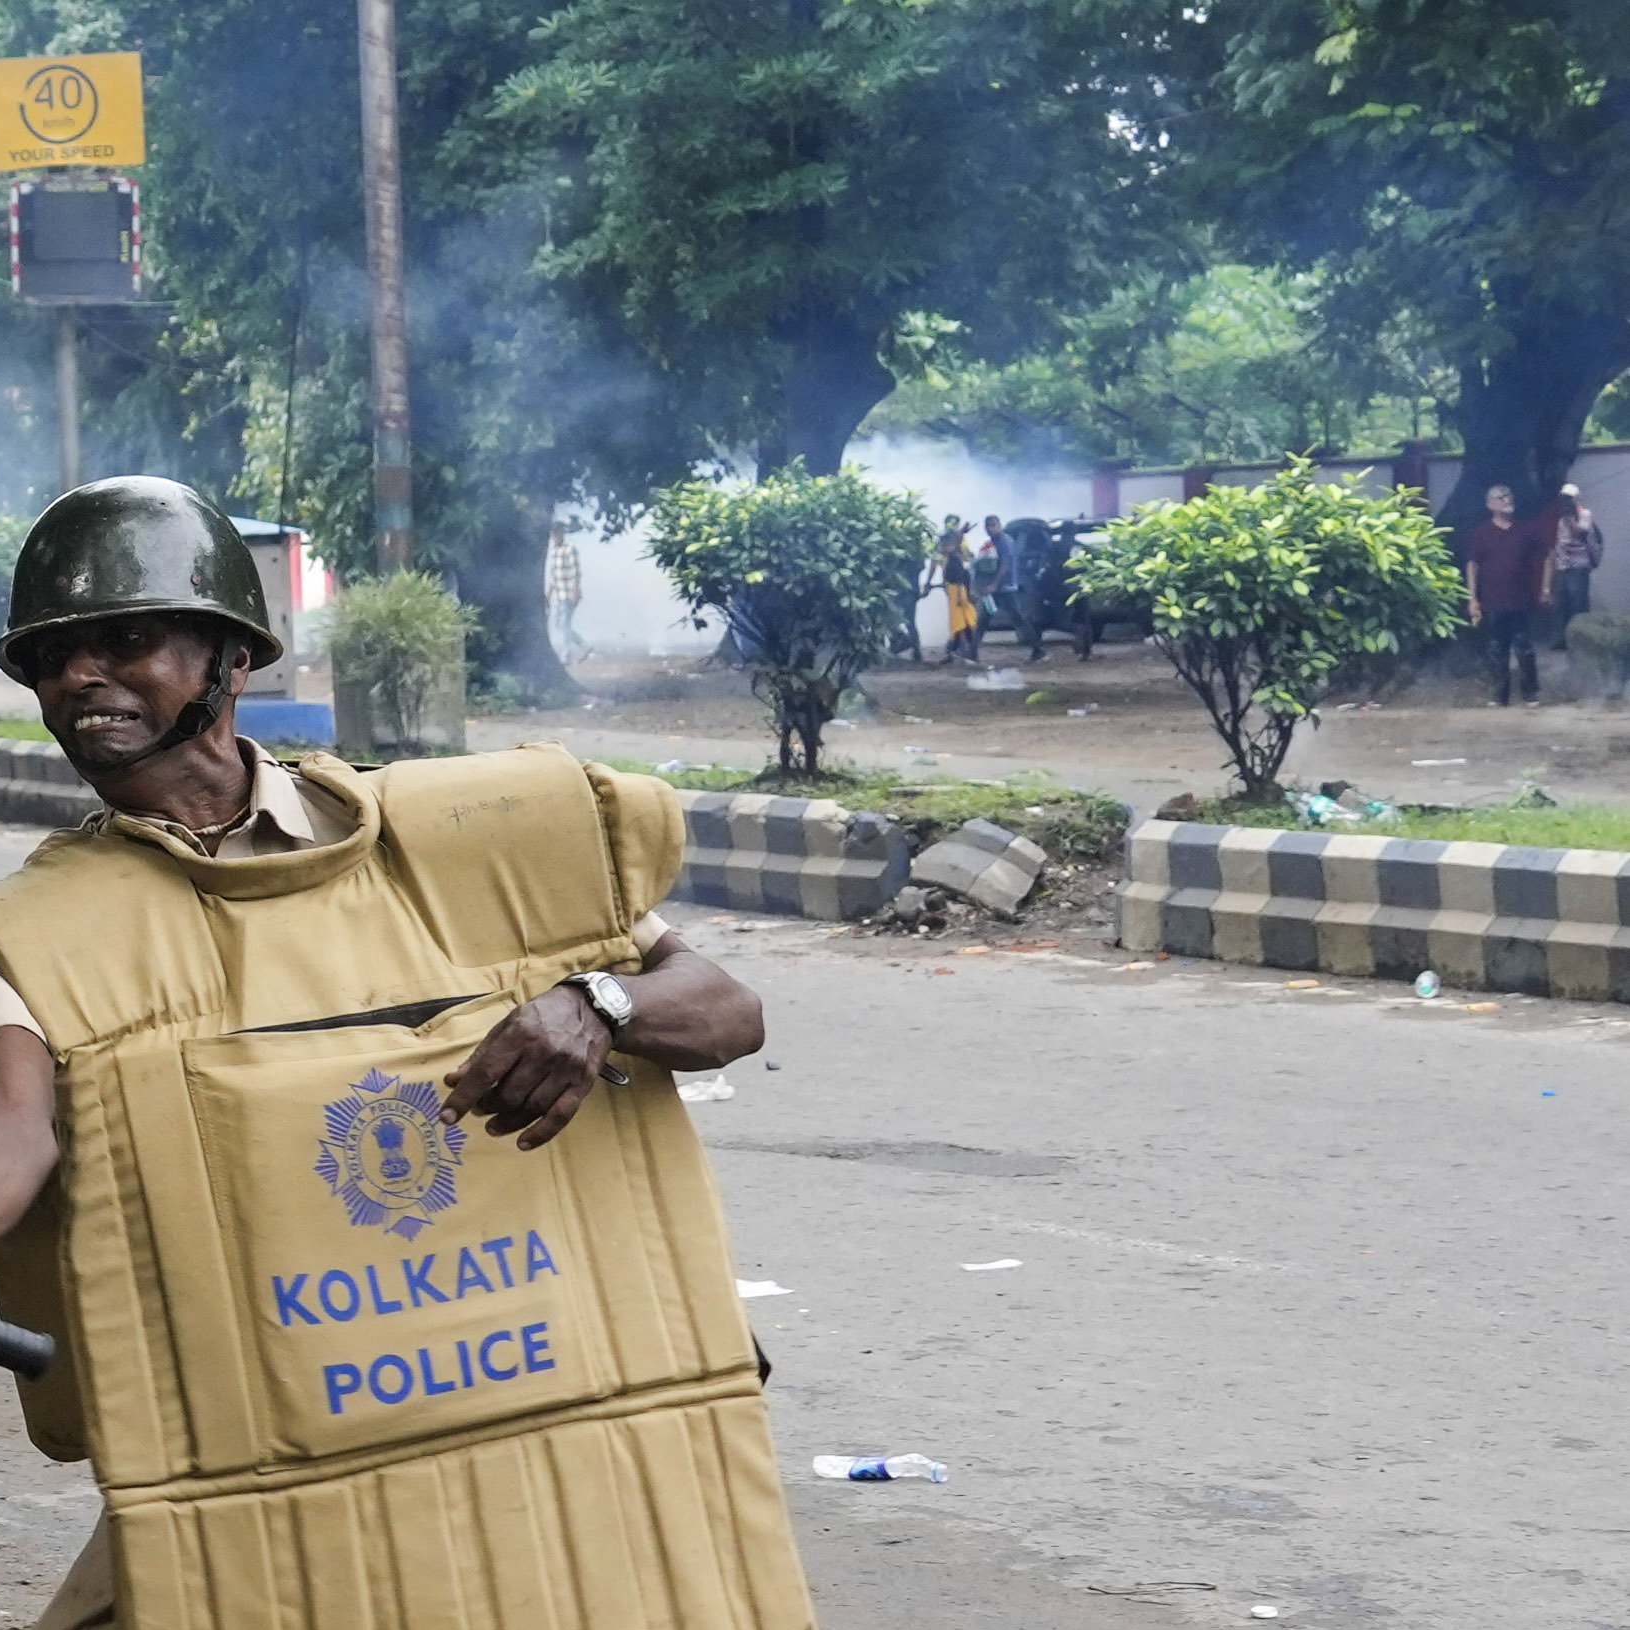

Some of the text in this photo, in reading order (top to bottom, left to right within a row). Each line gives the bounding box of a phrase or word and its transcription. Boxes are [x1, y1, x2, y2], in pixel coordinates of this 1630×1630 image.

[35, 75, 82, 110] 40
[9, 145, 114, 162] YOUR SPEED
[346, 1117, 367, 1181] KOLKATA
[370, 1102, 416, 1118] POLICE
[272, 1230, 559, 1326] KOLKATA
[323, 1322, 555, 1414] POLICE
